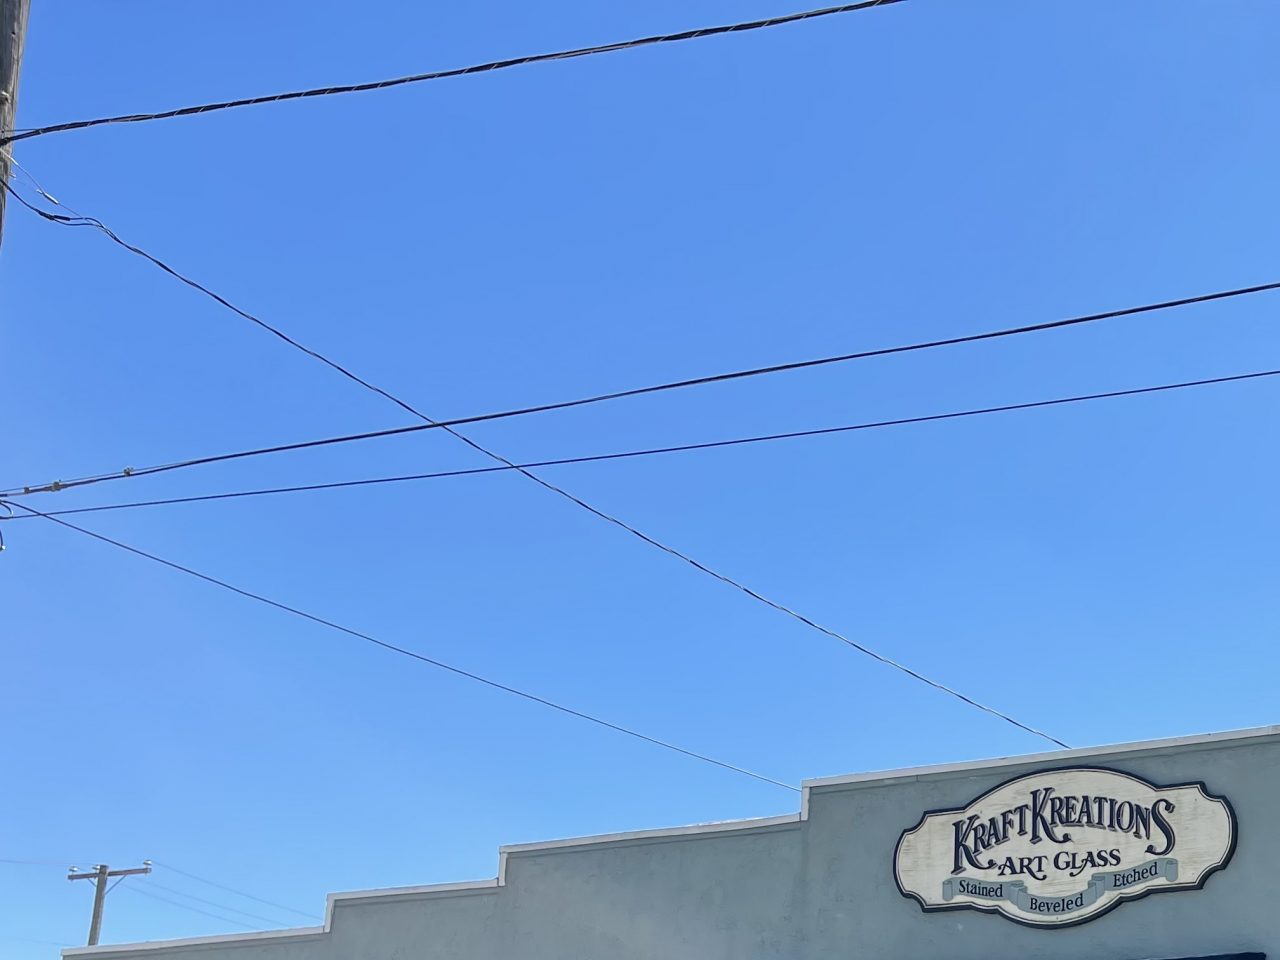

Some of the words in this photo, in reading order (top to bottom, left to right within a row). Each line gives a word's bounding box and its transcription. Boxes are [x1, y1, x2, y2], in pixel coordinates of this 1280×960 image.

[998, 855, 1048, 880] ART
[1053, 849, 1121, 877] GLASS
[1113, 862, 1158, 888] Etched
[959, 879, 1003, 898] Stained
[1029, 894, 1085, 913] Beveled
